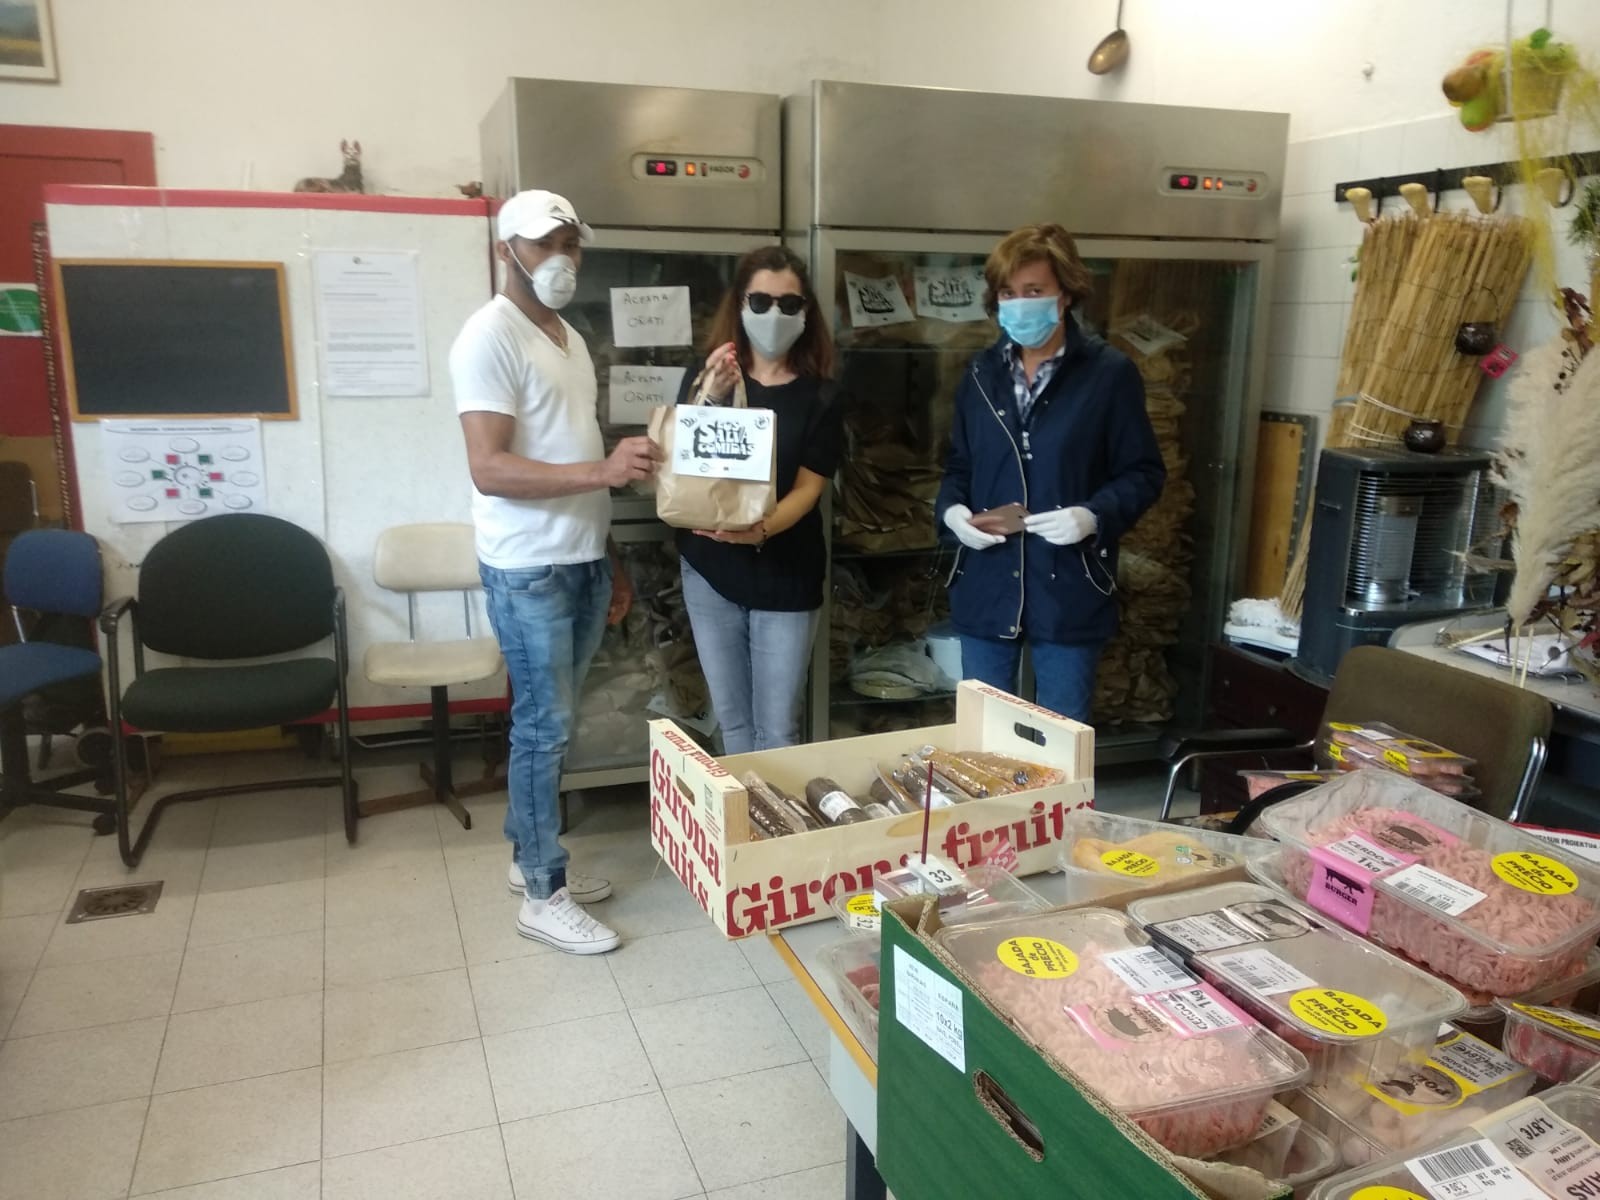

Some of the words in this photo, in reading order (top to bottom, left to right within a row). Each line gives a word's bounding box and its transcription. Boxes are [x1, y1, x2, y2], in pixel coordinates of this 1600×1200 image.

[652, 748, 721, 888] Girona
[651, 796, 709, 914] fruits
[1105, 851, 1136, 867] BAJADA
[1123, 858, 1149, 872] PRECIO
[1347, 840, 1385, 862] CERDO
[929, 869, 953, 884] 33
[1506, 860, 1554, 890] PRECIO
[1520, 853, 1575, 889] BAJADA
[1530, 868, 1546, 878] de
[727, 853, 912, 937] Giron
[1324, 882, 1359, 907] BURGER
[1008, 940, 1036, 975] BAJADA
[1028, 952, 1040, 961] de
[1032, 942, 1059, 972] PRECIO
[1175, 1003, 1208, 1031] CERDO
[1306, 997, 1359, 1031] PRECIO
[1323, 991, 1383, 1029] BAJADA
[1334, 1006, 1350, 1017] de
[936, 1011, 953, 1031] 10x2
[953, 1023, 963, 1041] kg
[1519, 1116, 1554, 1142] 1,87€
